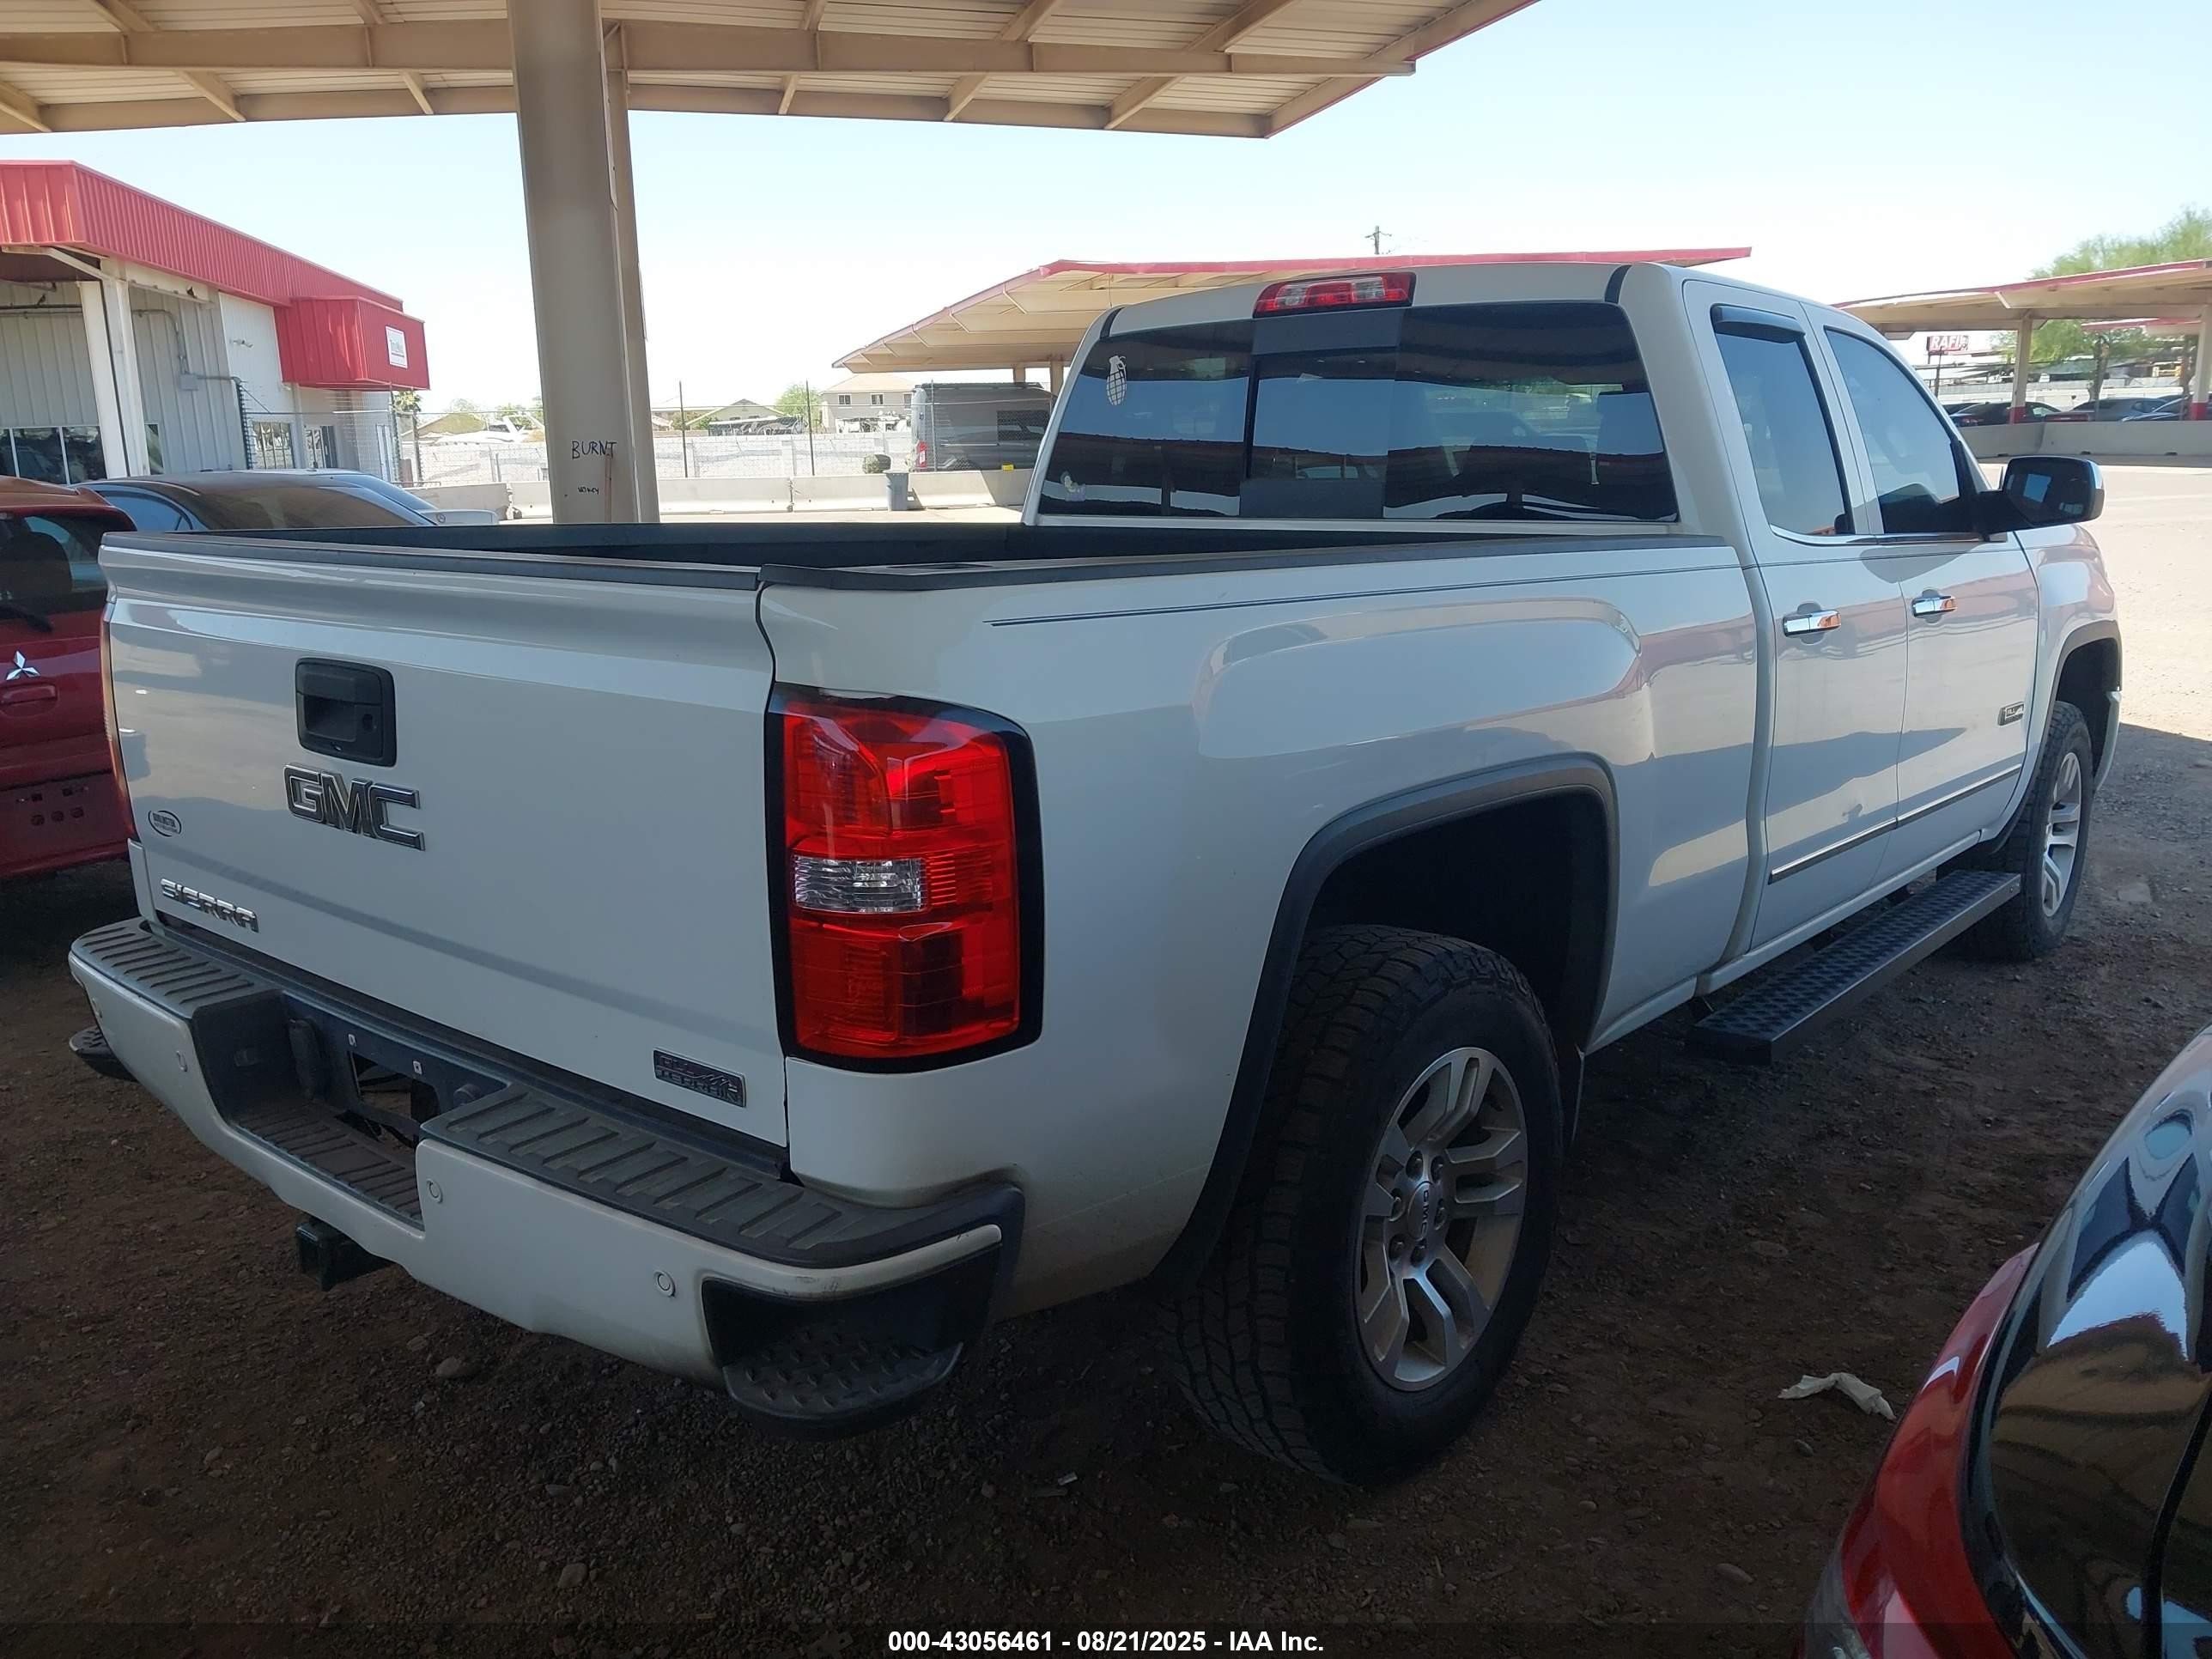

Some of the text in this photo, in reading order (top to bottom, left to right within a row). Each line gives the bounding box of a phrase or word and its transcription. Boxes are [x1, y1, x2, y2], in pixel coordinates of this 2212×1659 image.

[572, 440, 617, 459] BURNT
[283, 763, 426, 851] GMC
[161, 878, 259, 933] SIERRA
